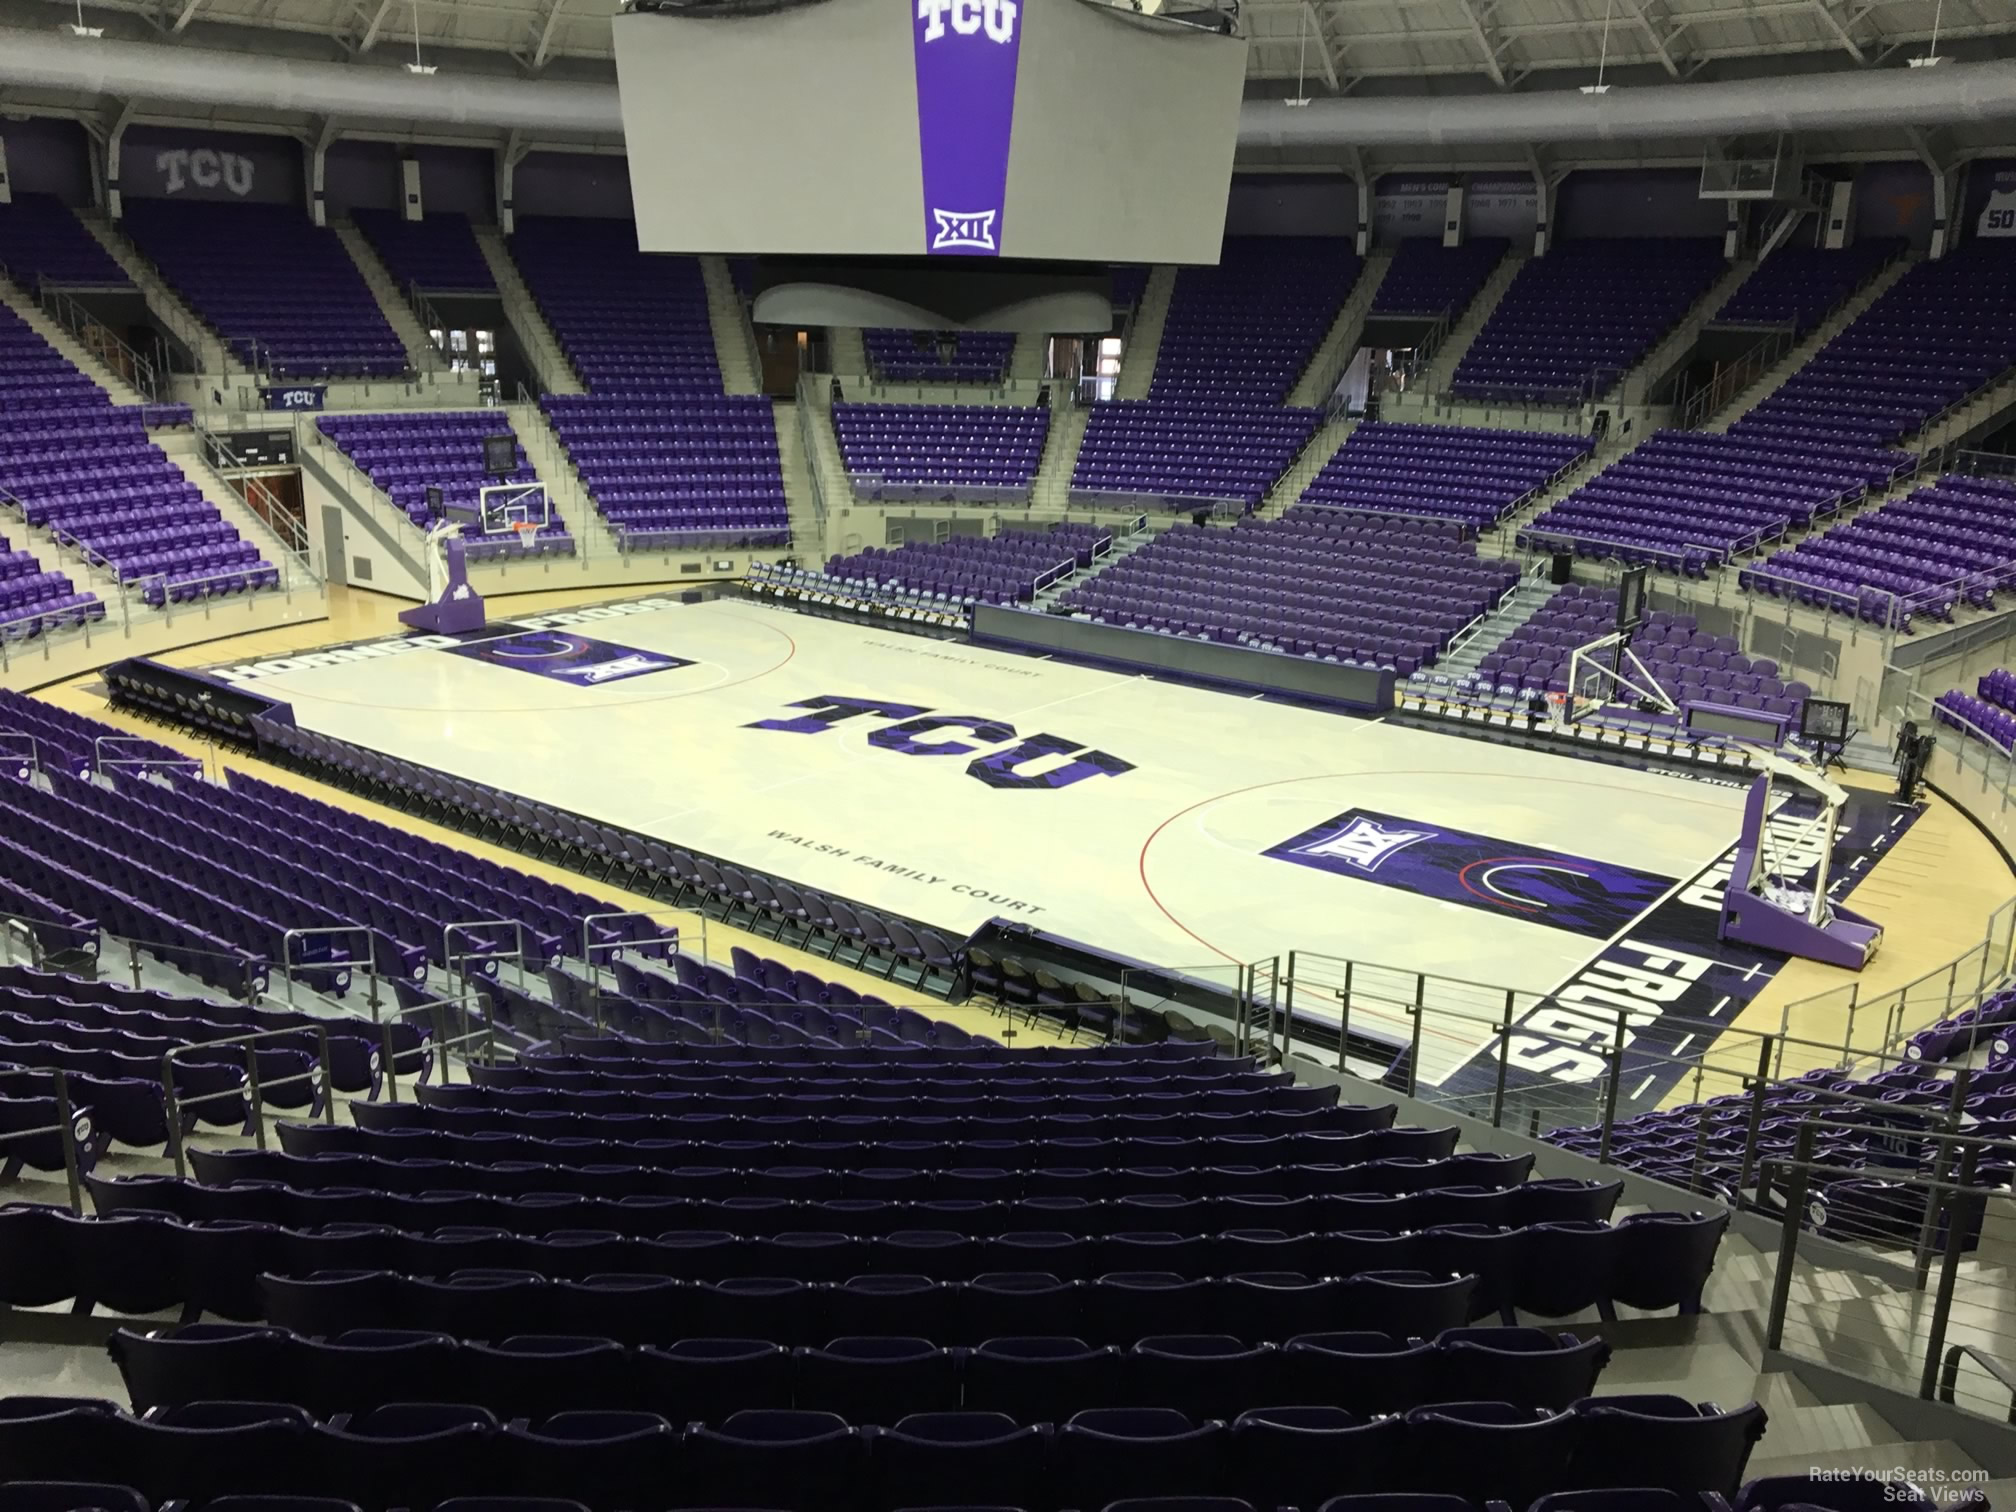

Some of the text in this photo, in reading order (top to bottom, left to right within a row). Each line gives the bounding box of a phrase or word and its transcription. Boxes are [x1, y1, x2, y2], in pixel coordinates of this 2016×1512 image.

[918, 0, 1017, 44] TCU
[156, 148, 255, 195] TCU
[283, 390, 315, 407] TCU
[510, 597, 685, 630] FROGS
[208, 635, 461, 682] HORNED
[920, 651, 981, 665] FAMILY
[984, 663, 1044, 678] COURT
[737, 694, 1139, 789] TCU
[767, 829, 1049, 915] WALSH FAMILY COURT
[1490, 938, 1714, 1084] FROGS
